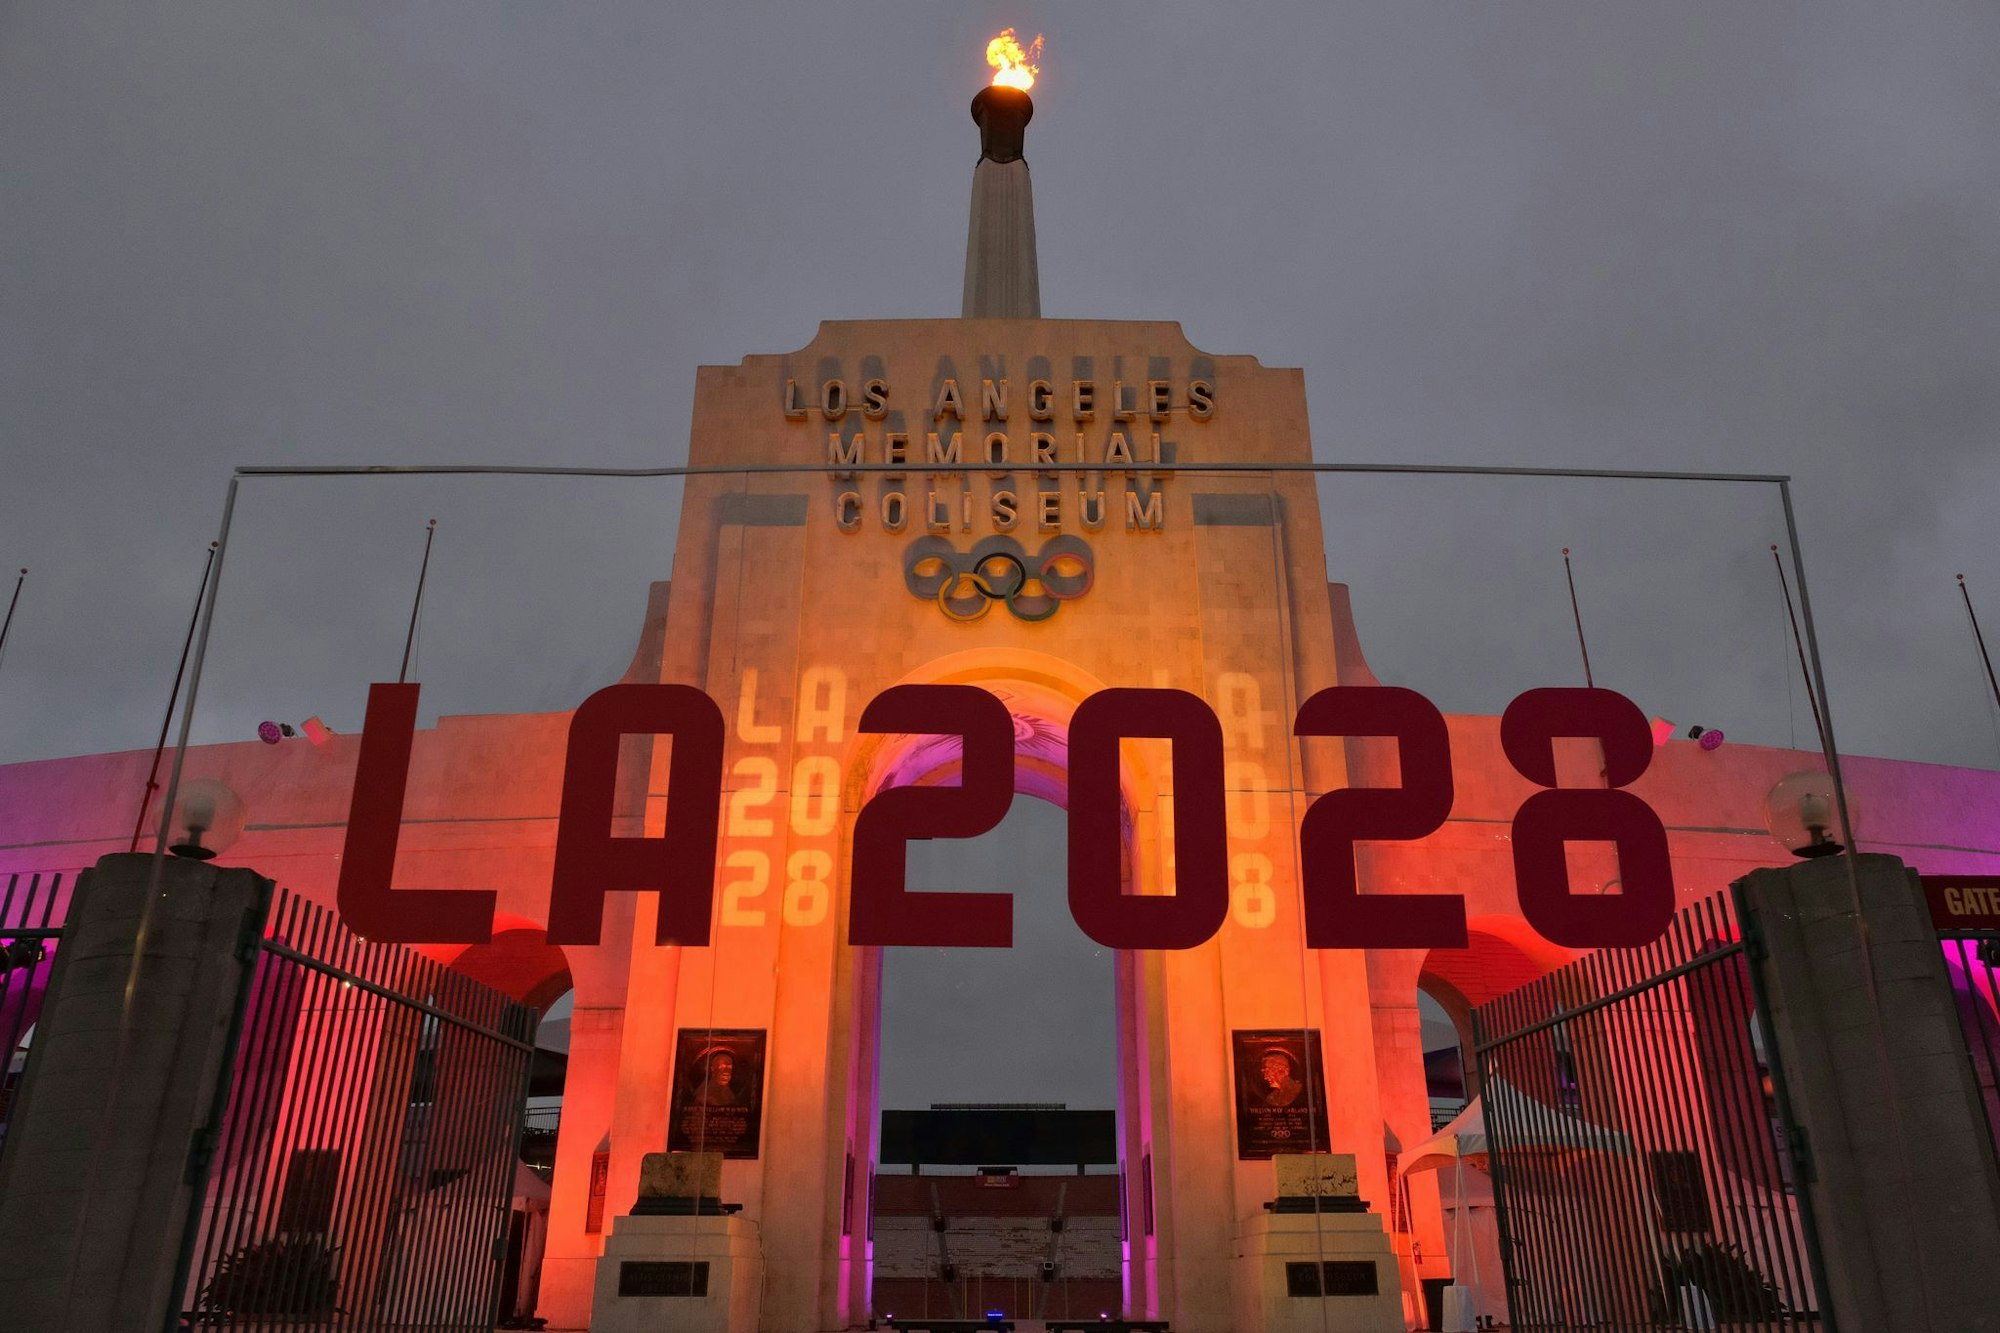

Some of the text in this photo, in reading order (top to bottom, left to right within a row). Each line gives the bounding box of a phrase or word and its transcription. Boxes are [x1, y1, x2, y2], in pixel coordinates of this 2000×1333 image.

[785, 378, 1215, 421] LOS ANGELES
[828, 432, 1175, 480] MEMORIAL
[836, 491, 1164, 533] COLISEUM
[736, 666, 846, 743] LA
[336, 683, 1675, 950] LA 2028
[727, 755, 841, 837] 20
[721, 849, 833, 927] 28
[1943, 887, 2000, 916] GATE
